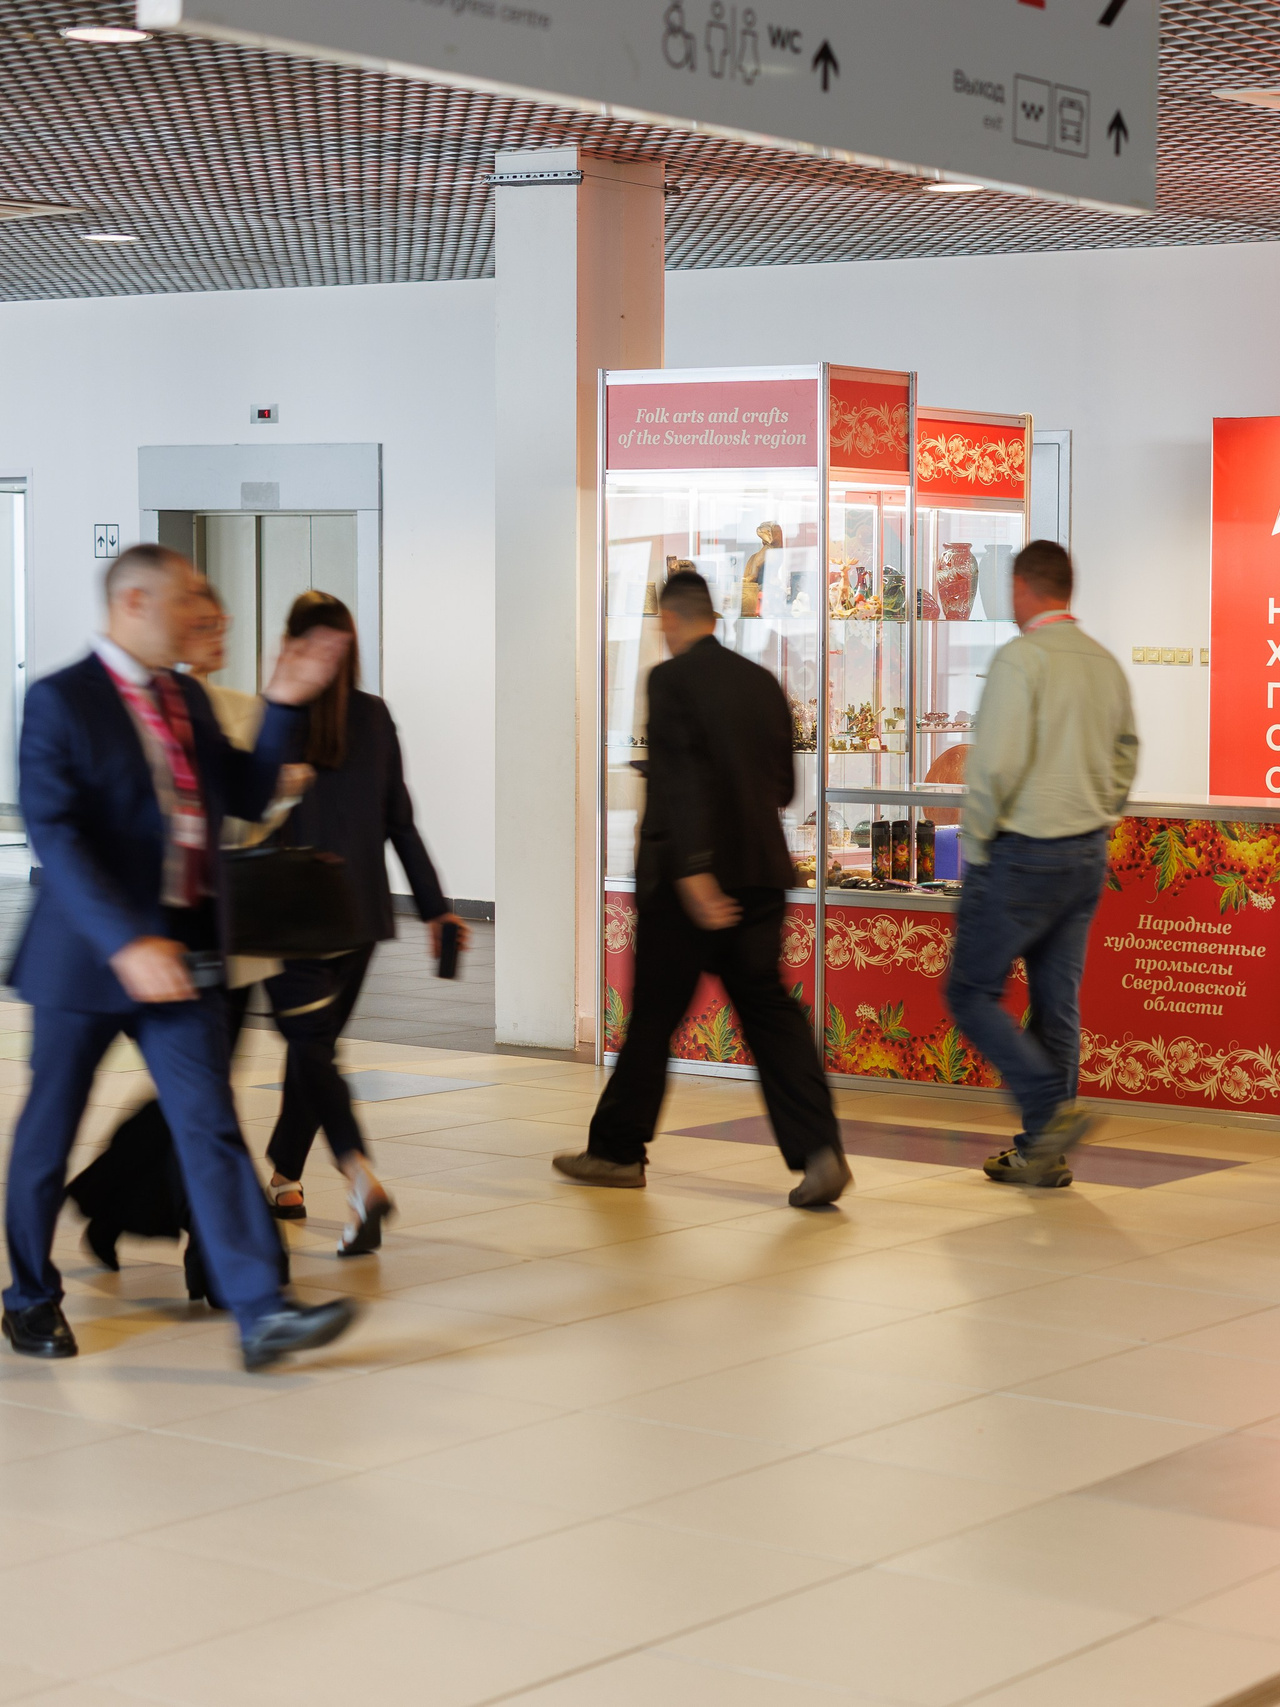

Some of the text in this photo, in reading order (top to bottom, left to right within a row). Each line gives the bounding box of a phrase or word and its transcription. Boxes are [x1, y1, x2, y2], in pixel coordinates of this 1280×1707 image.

[767, 24, 802, 54] WC
[953, 69, 1005, 104] Выход
[635, 407, 789, 427] Folk arts and crafts
[617, 429, 807, 449] of the Sverdlovsk region
[1137, 914, 1232, 935] Народные
[1103, 932, 1267, 957] художественные
[1134, 957, 1233, 976] промыслы
[1121, 973, 1247, 998] Свердловской
[1143, 996, 1224, 1016] области
